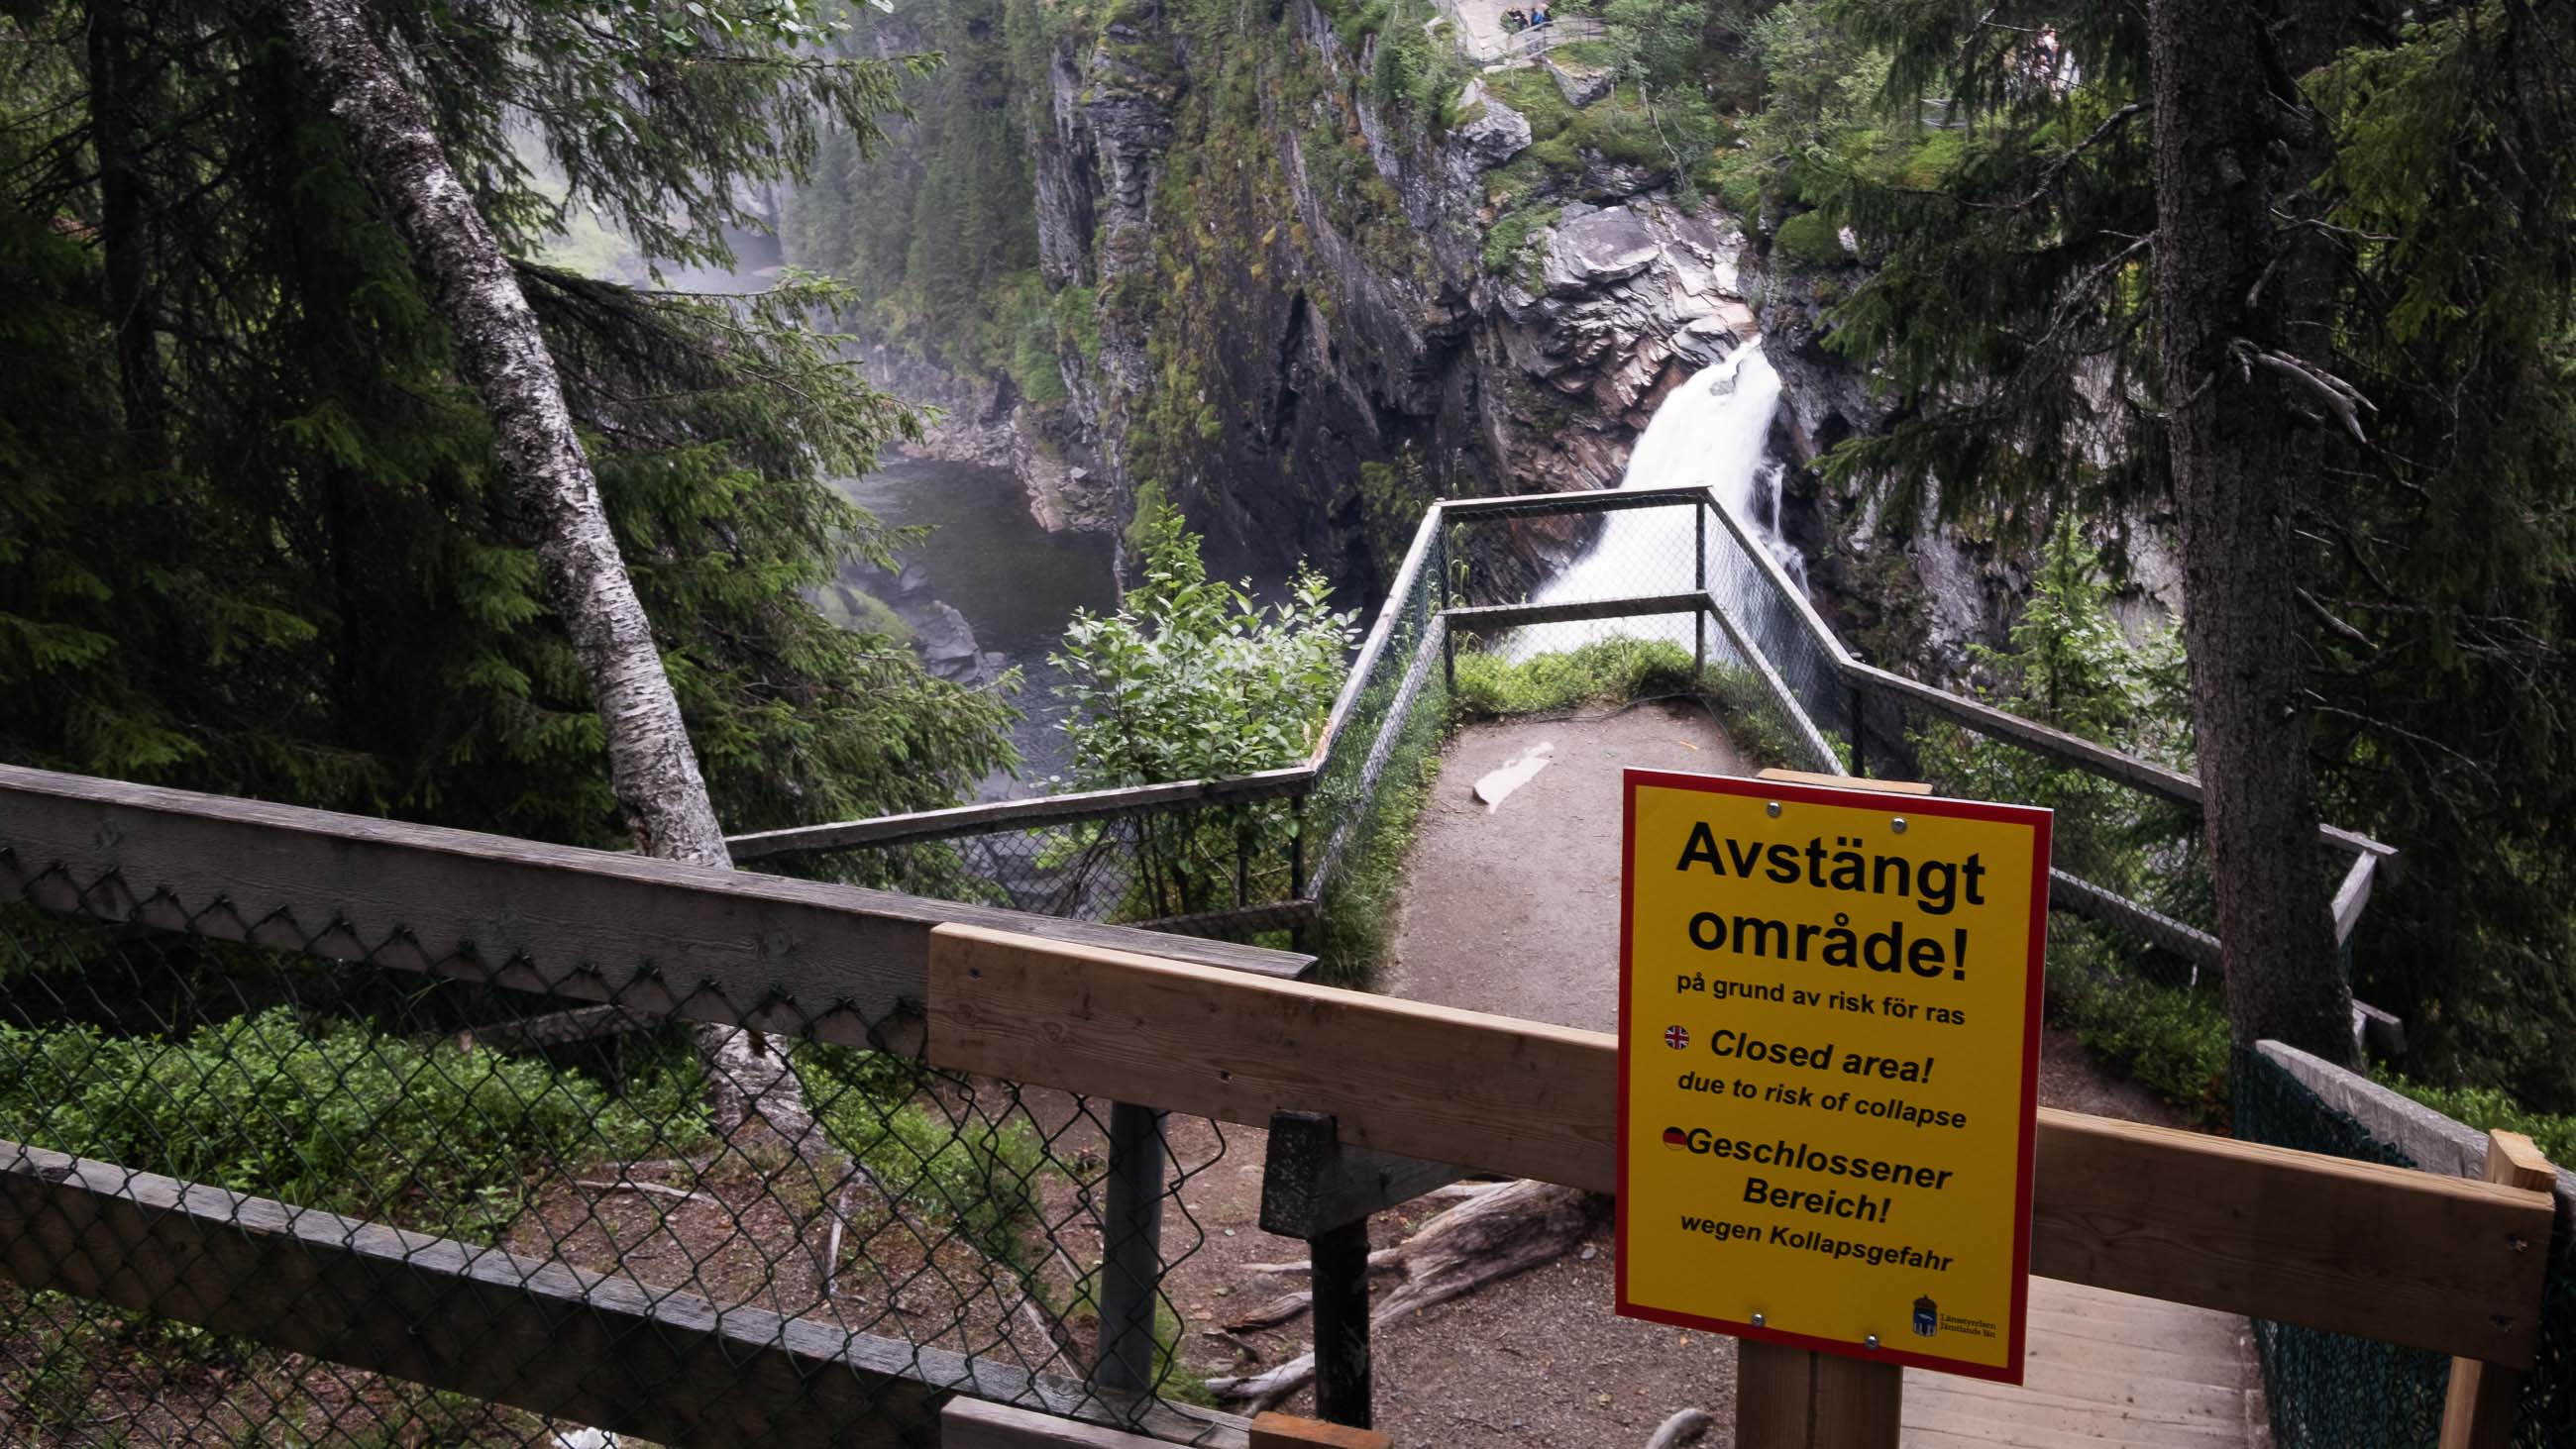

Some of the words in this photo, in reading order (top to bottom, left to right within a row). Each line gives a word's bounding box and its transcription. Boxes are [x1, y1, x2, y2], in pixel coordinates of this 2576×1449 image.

[1676, 821, 1985, 915] Avstängt
[1688, 911, 1968, 981] område!
[1676, 972, 1705, 993] på
[1713, 978, 1783, 1002] grund
[1792, 988, 1821, 1006] av
[1829, 990, 1875, 1013] risk
[1882, 996, 1916, 1019] för
[1926, 1005, 1965, 1025] ras
[1711, 1029, 1833, 1070] Closed
[1842, 1054, 1934, 1084] area!
[1678, 1072, 1724, 1093] due
[1733, 1079, 1757, 1098] to
[1765, 1084, 1813, 1106] risk
[1821, 1092, 1850, 1111] of
[1855, 1096, 1967, 1129] collapse
[1686, 1128, 1953, 1190] Geschlossener
[1743, 1178, 1891, 1223] Bereich!
[1680, 1215, 1762, 1242] wegen
[1770, 1226, 1953, 1272] Kollapsgefahr
